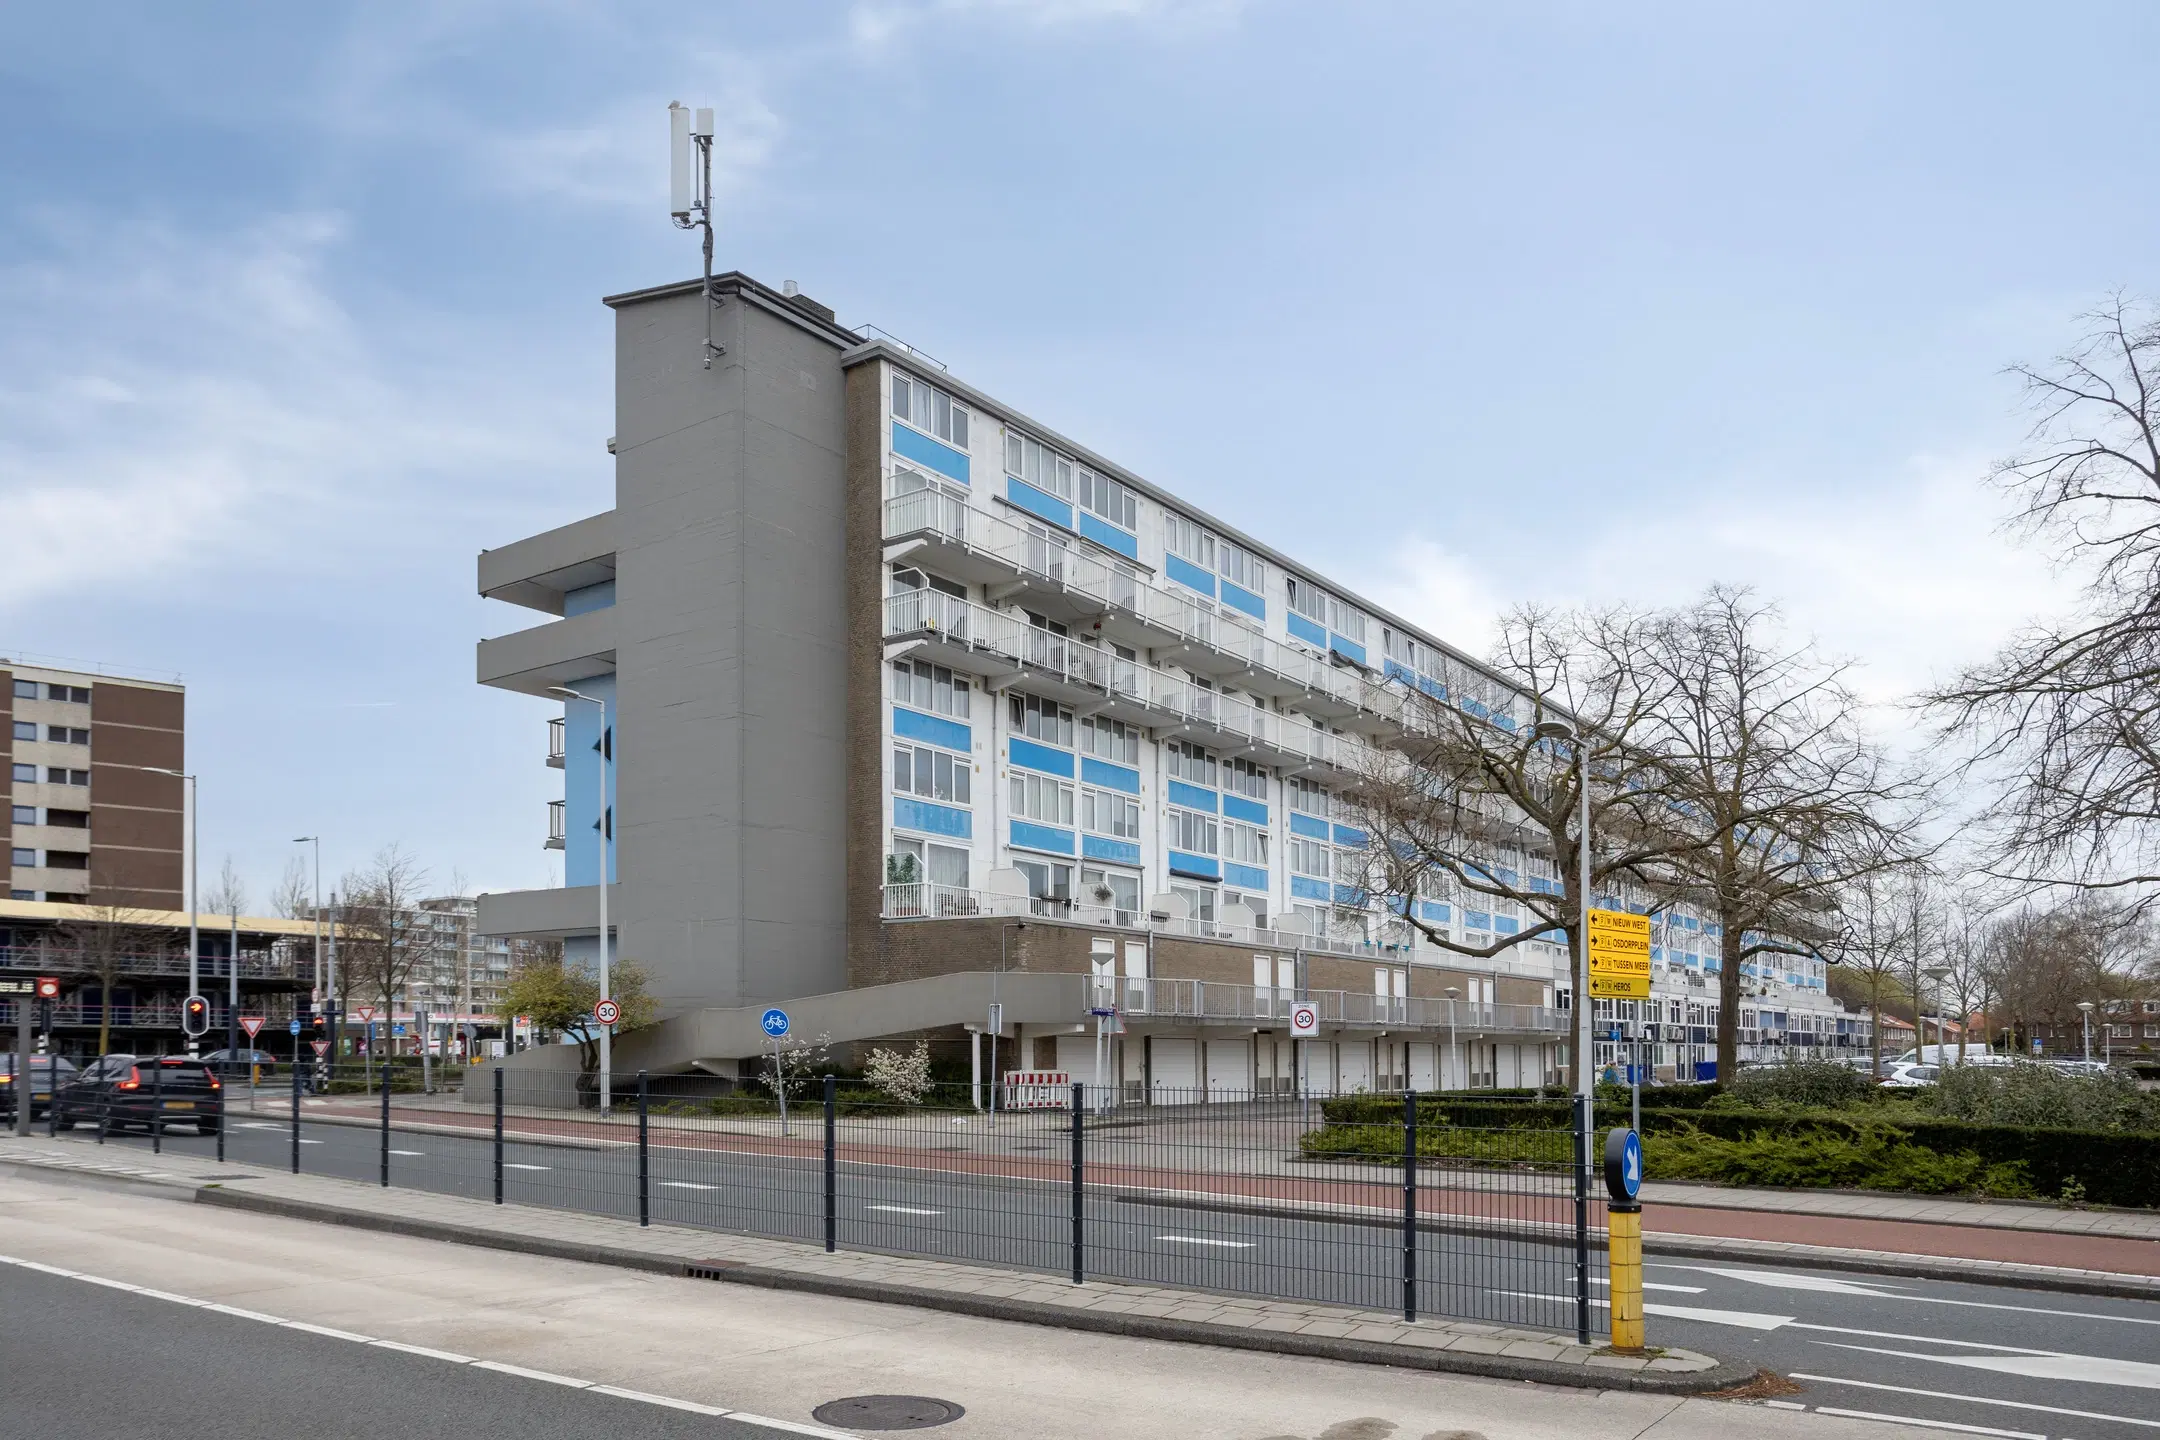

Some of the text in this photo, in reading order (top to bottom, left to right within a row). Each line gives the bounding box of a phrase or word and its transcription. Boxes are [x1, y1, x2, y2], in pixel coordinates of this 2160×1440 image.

[1612, 918, 1631, 928] NIEUW
[1632, 920, 1646, 930] WEST
[1612, 938, 1648, 950] OSDORPPLEIN
[1613, 959, 1633, 970] TUSSEN
[1634, 961, 1648, 970] MEER
[1613, 981, 1631, 992] HEROS
[600, 1007, 616, 1017] 30
[1298, 1015, 1311, 1023] 30
